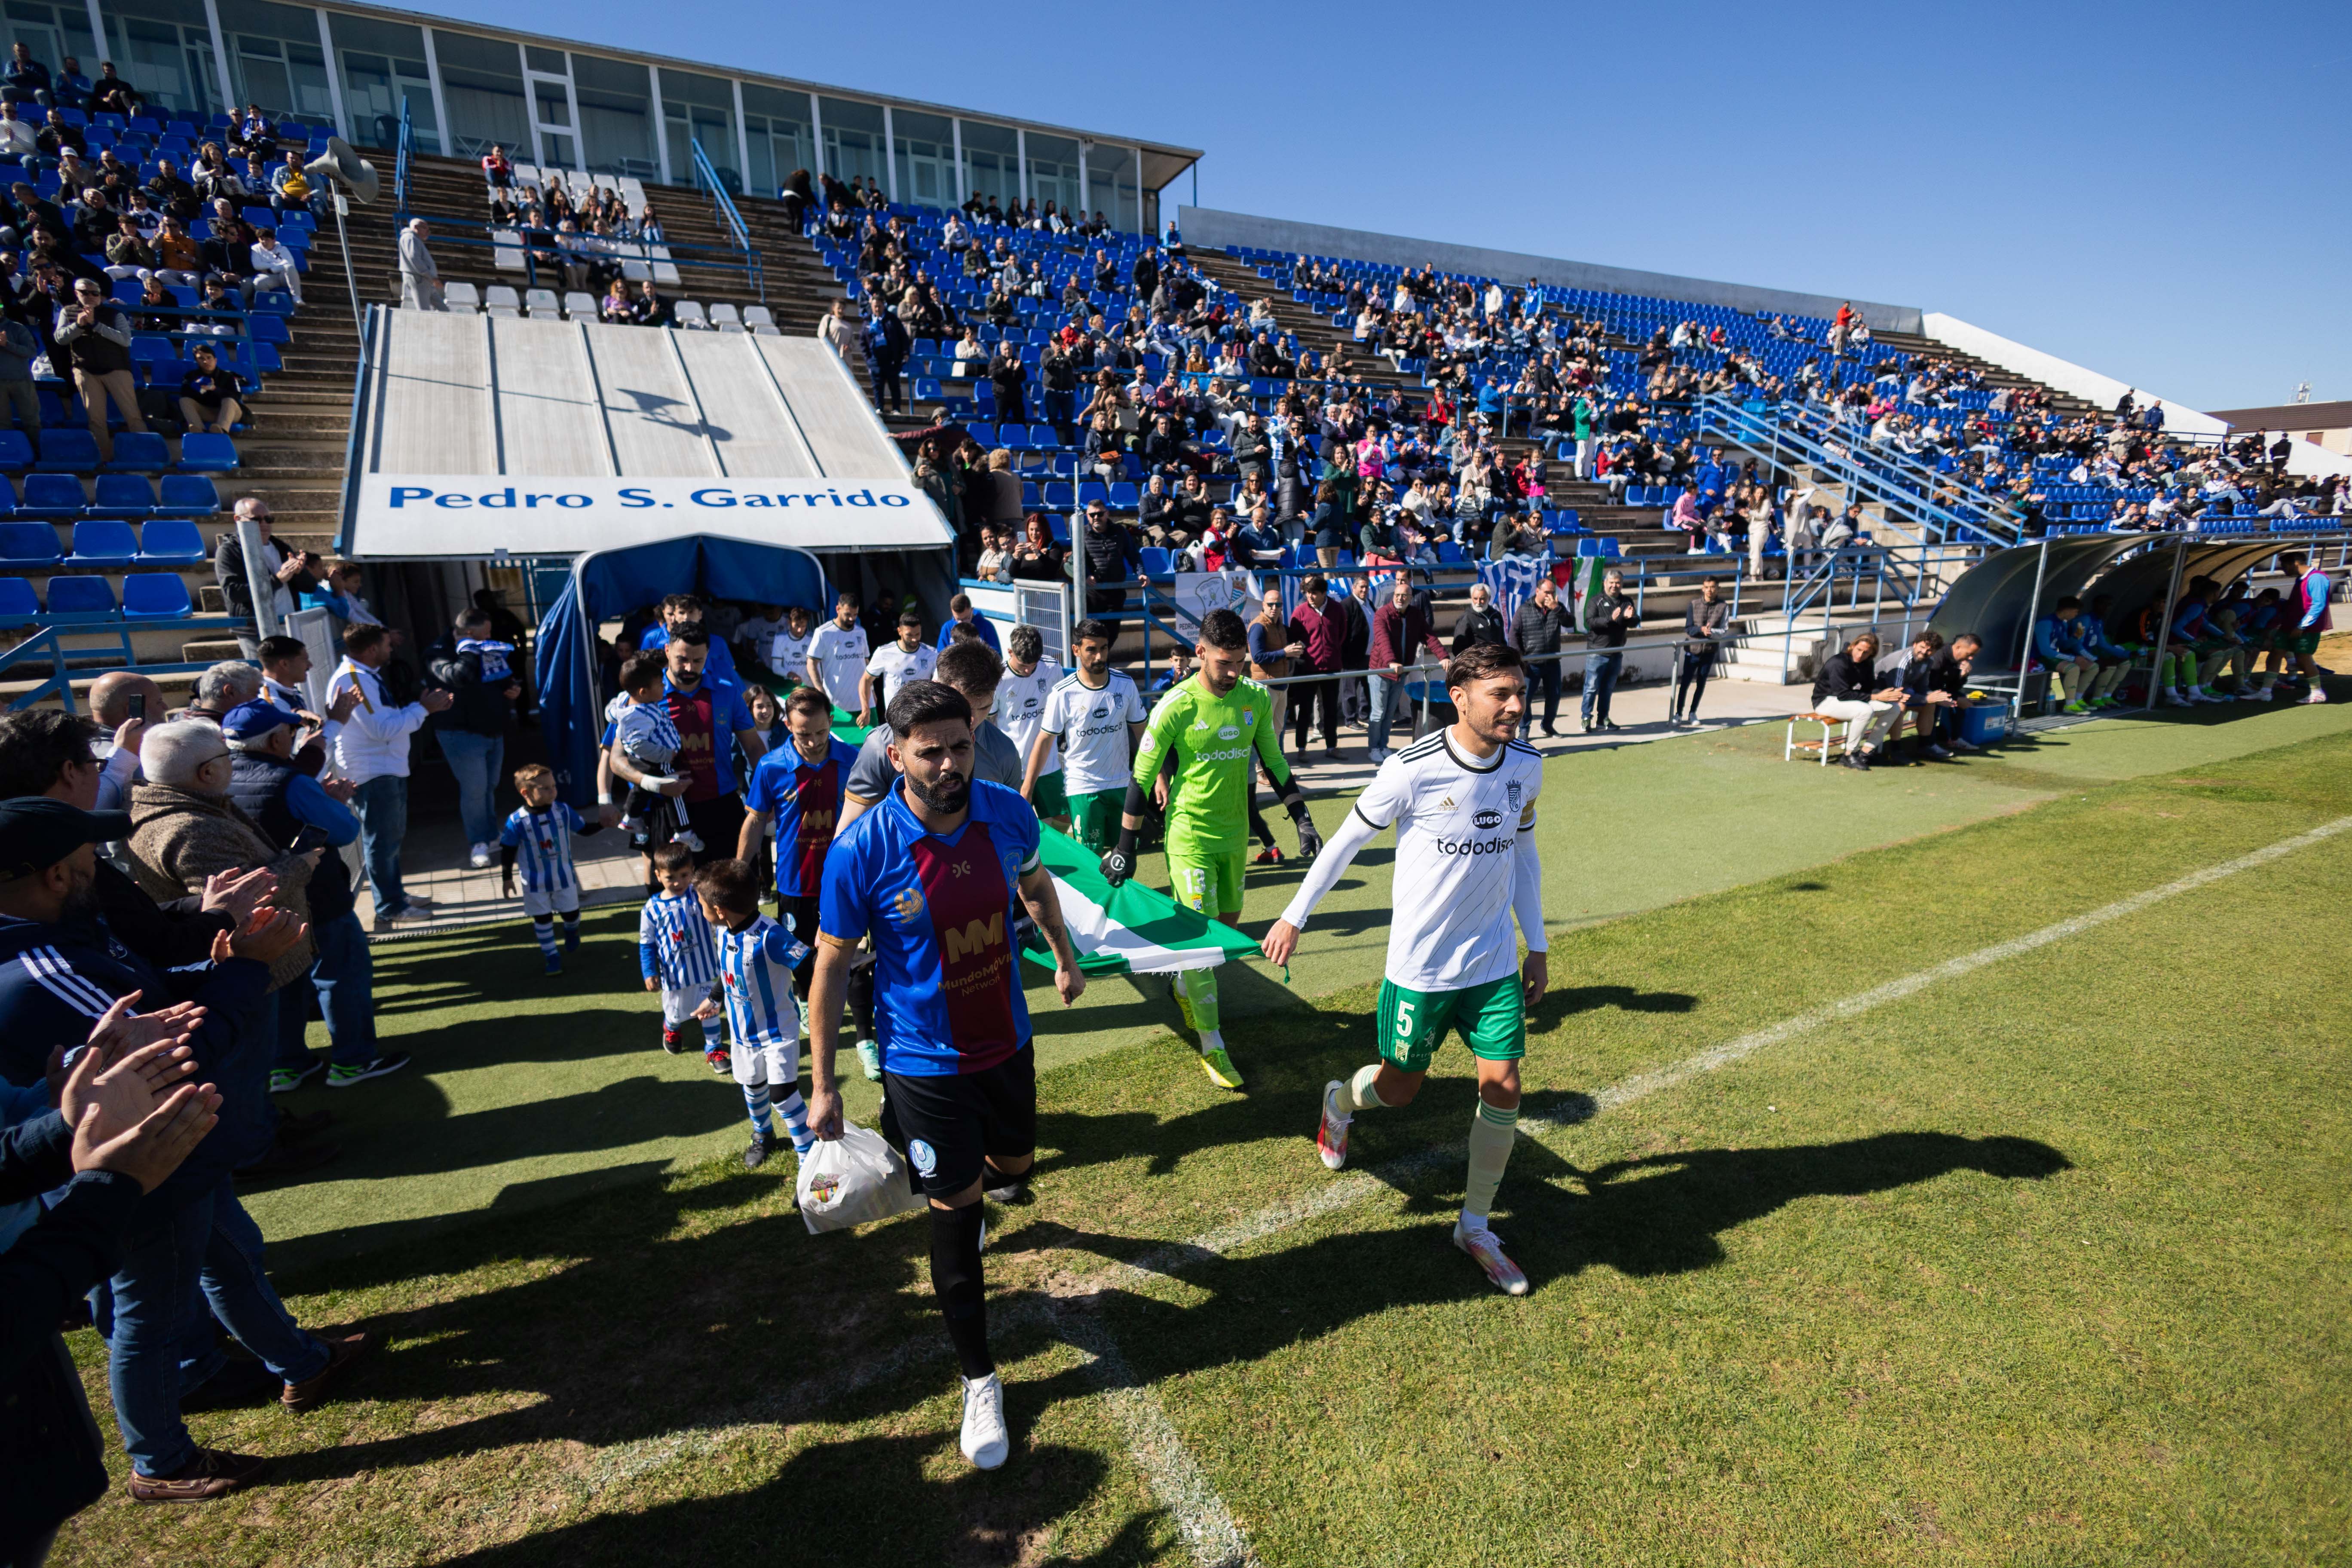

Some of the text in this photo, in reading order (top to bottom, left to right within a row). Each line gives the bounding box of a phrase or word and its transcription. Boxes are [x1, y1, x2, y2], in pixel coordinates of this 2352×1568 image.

[389, 487, 910, 508] Pedro S. Garrido
[802, 809, 832, 830] MM
[1074, 815, 1082, 834] 4
[1474, 815, 1502, 825] LUGO
[1182, 868, 1206, 894] 13
[945, 912, 1003, 965] MM
[723, 969, 744, 991] MM
[1396, 1000, 1415, 1037] 5
